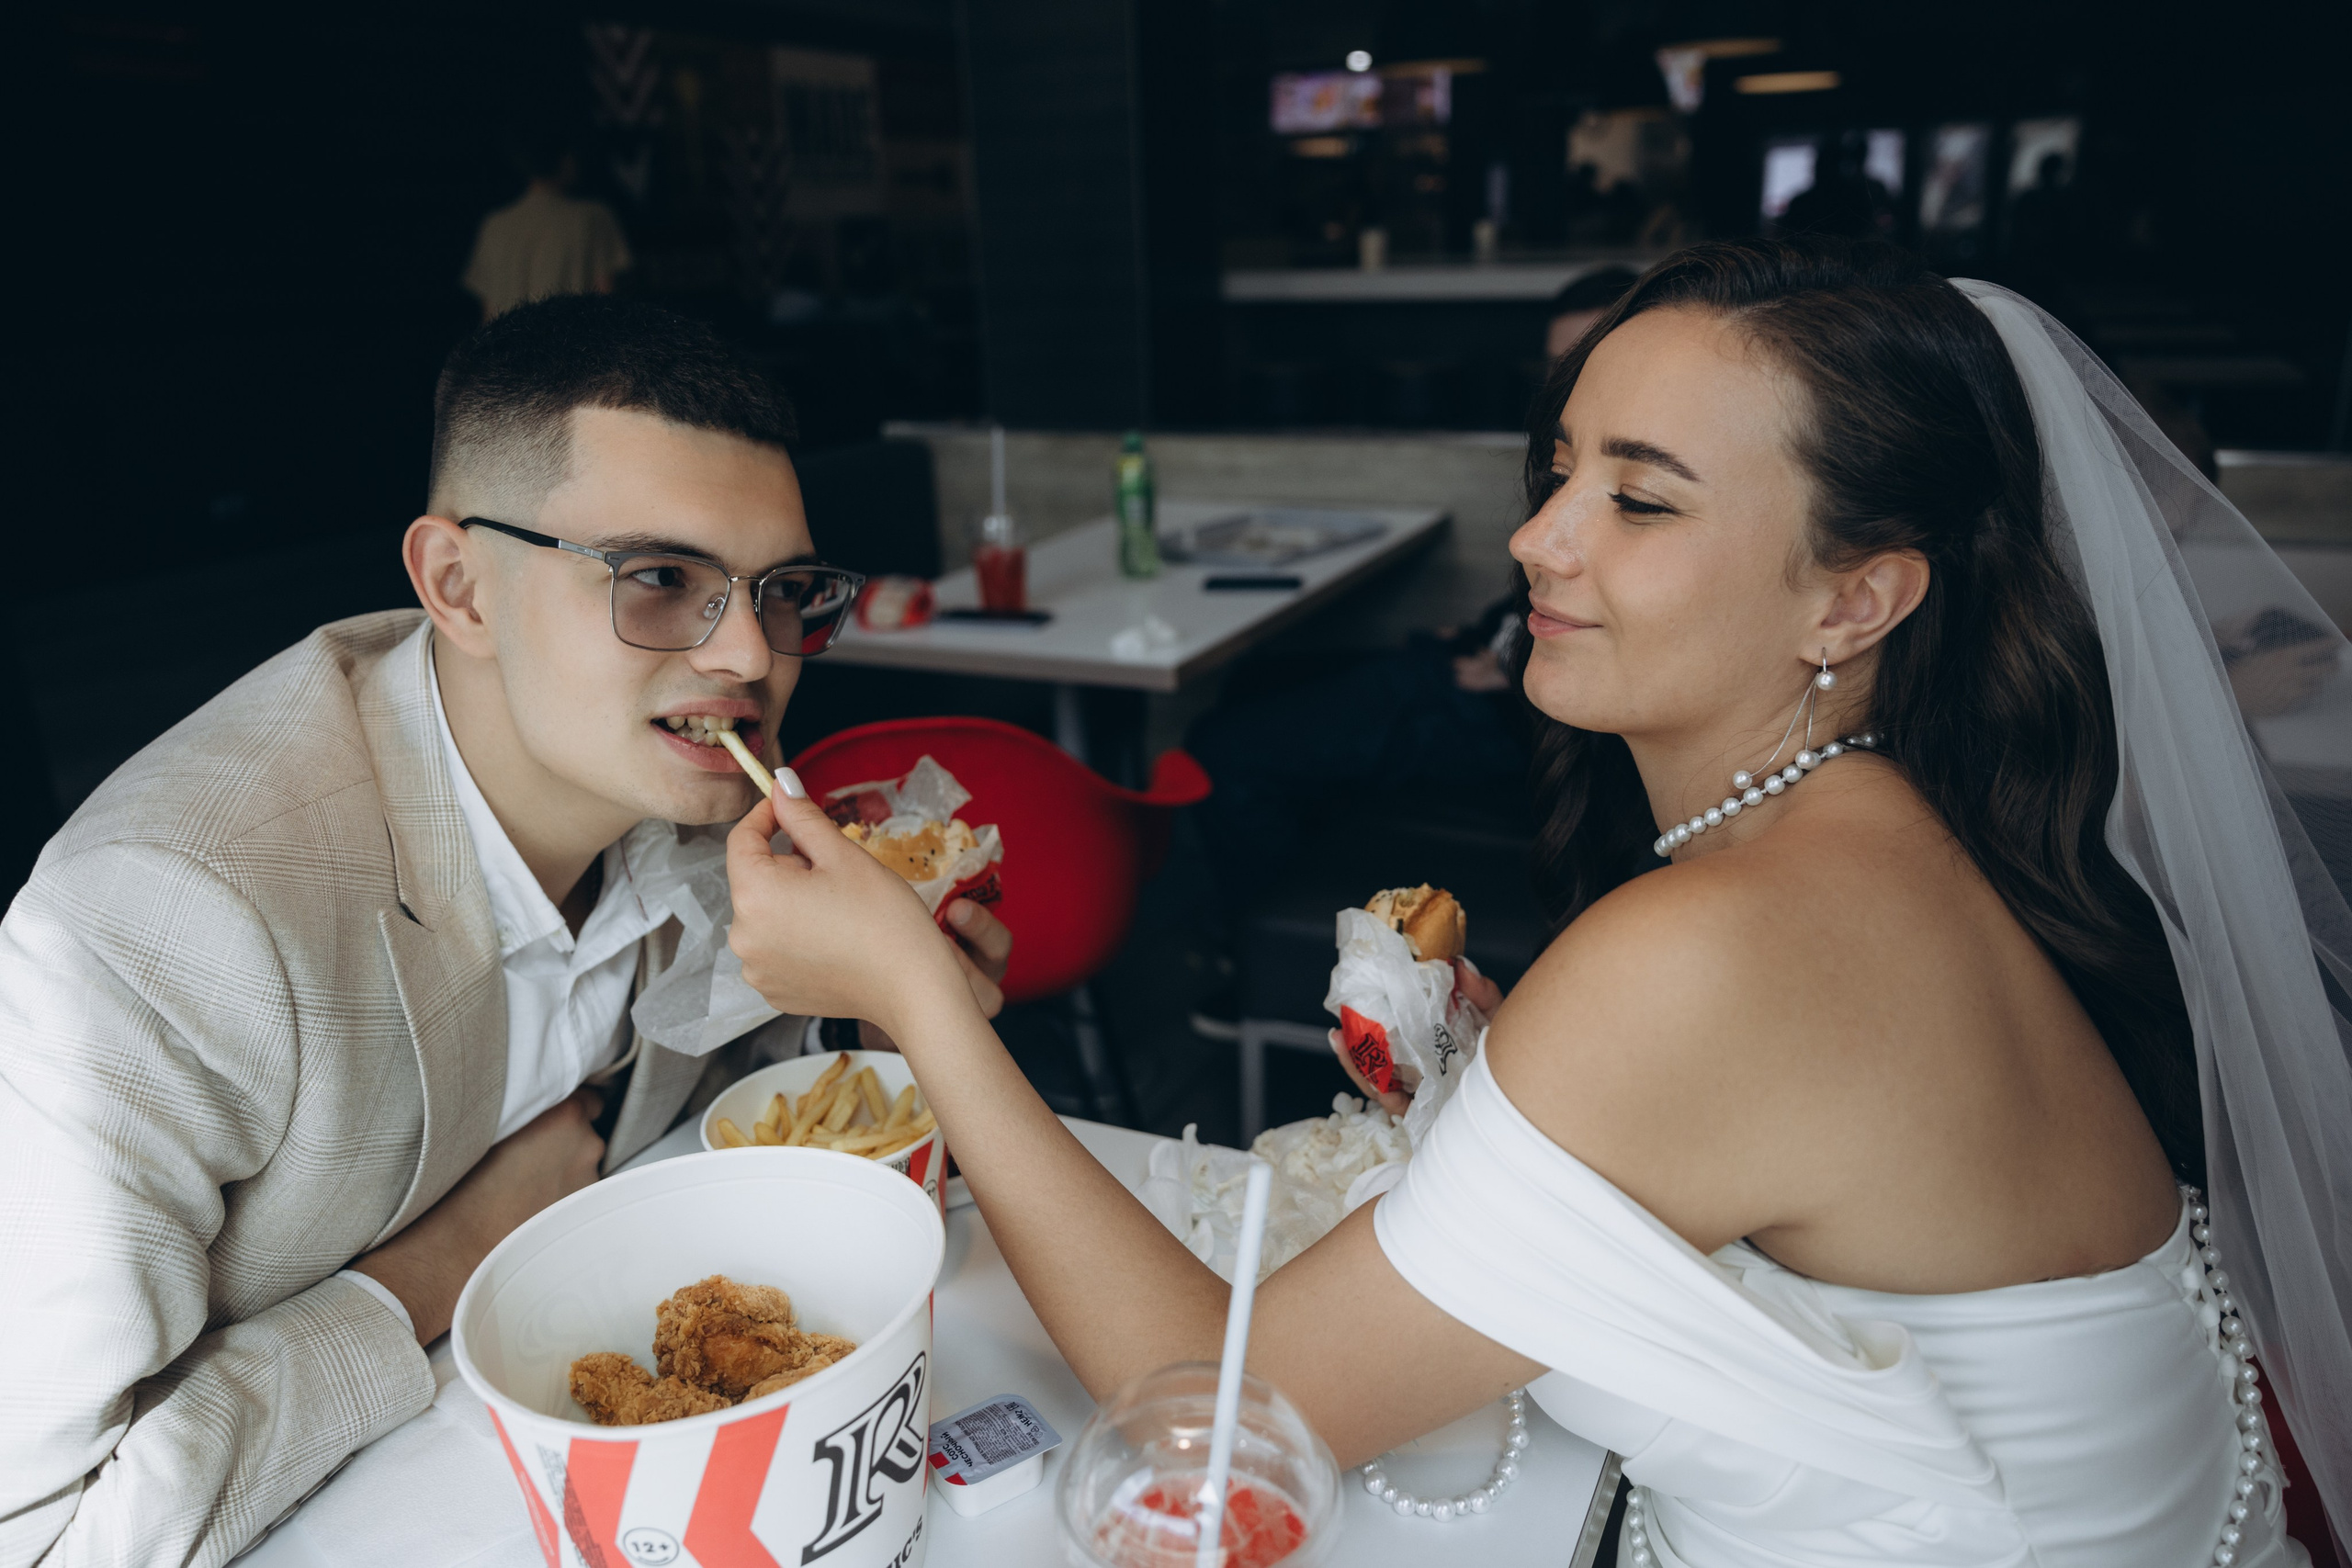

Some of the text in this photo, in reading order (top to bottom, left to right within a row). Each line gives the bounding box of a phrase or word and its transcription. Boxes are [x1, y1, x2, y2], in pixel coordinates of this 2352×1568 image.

[1014, 1409, 1033, 1427] HEINZ
[940, 1431, 973, 1468] ЧЕСНОЧНЫЙ
[942, 1443, 959, 1461] СОУС
[631, 1541, 670, 1552] 12+
